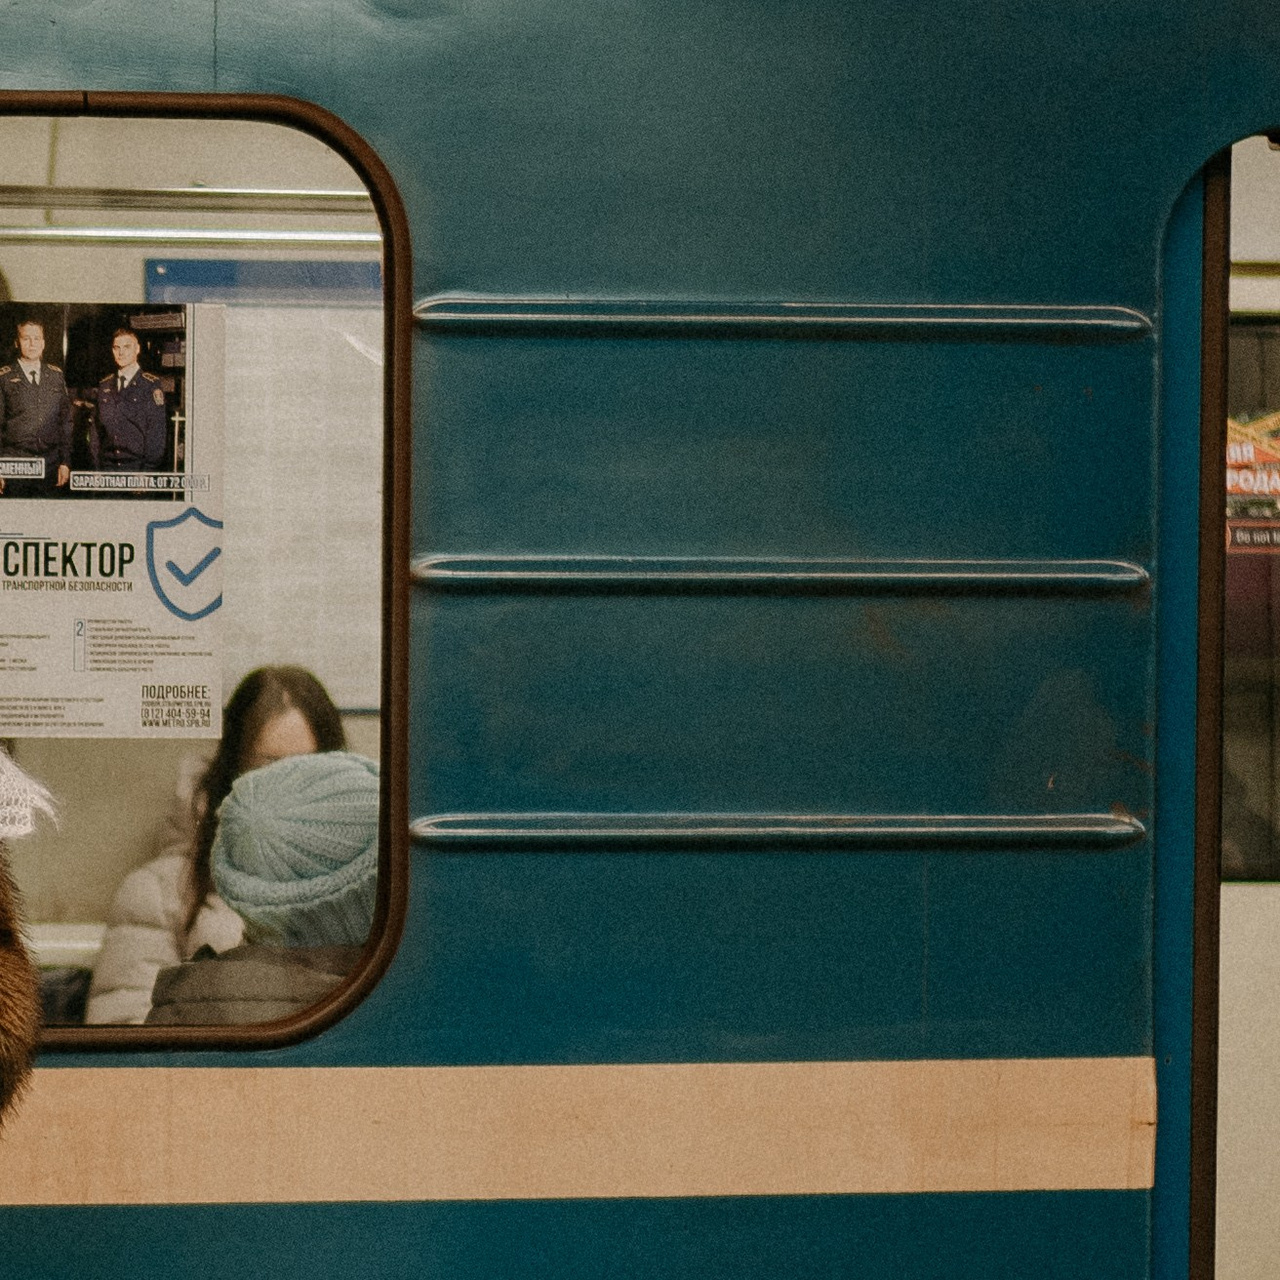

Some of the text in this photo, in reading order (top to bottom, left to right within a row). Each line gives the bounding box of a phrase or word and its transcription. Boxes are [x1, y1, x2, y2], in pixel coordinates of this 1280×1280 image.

[2, 579, 66, 591] ТРАНСПОРТНОЙ
[68, 581, 133, 592] БЕЗОПАСНОСТИ
[76, 621, 84, 636] 2
[141, 685, 211, 699] ПОДРОБНЕЕ:
